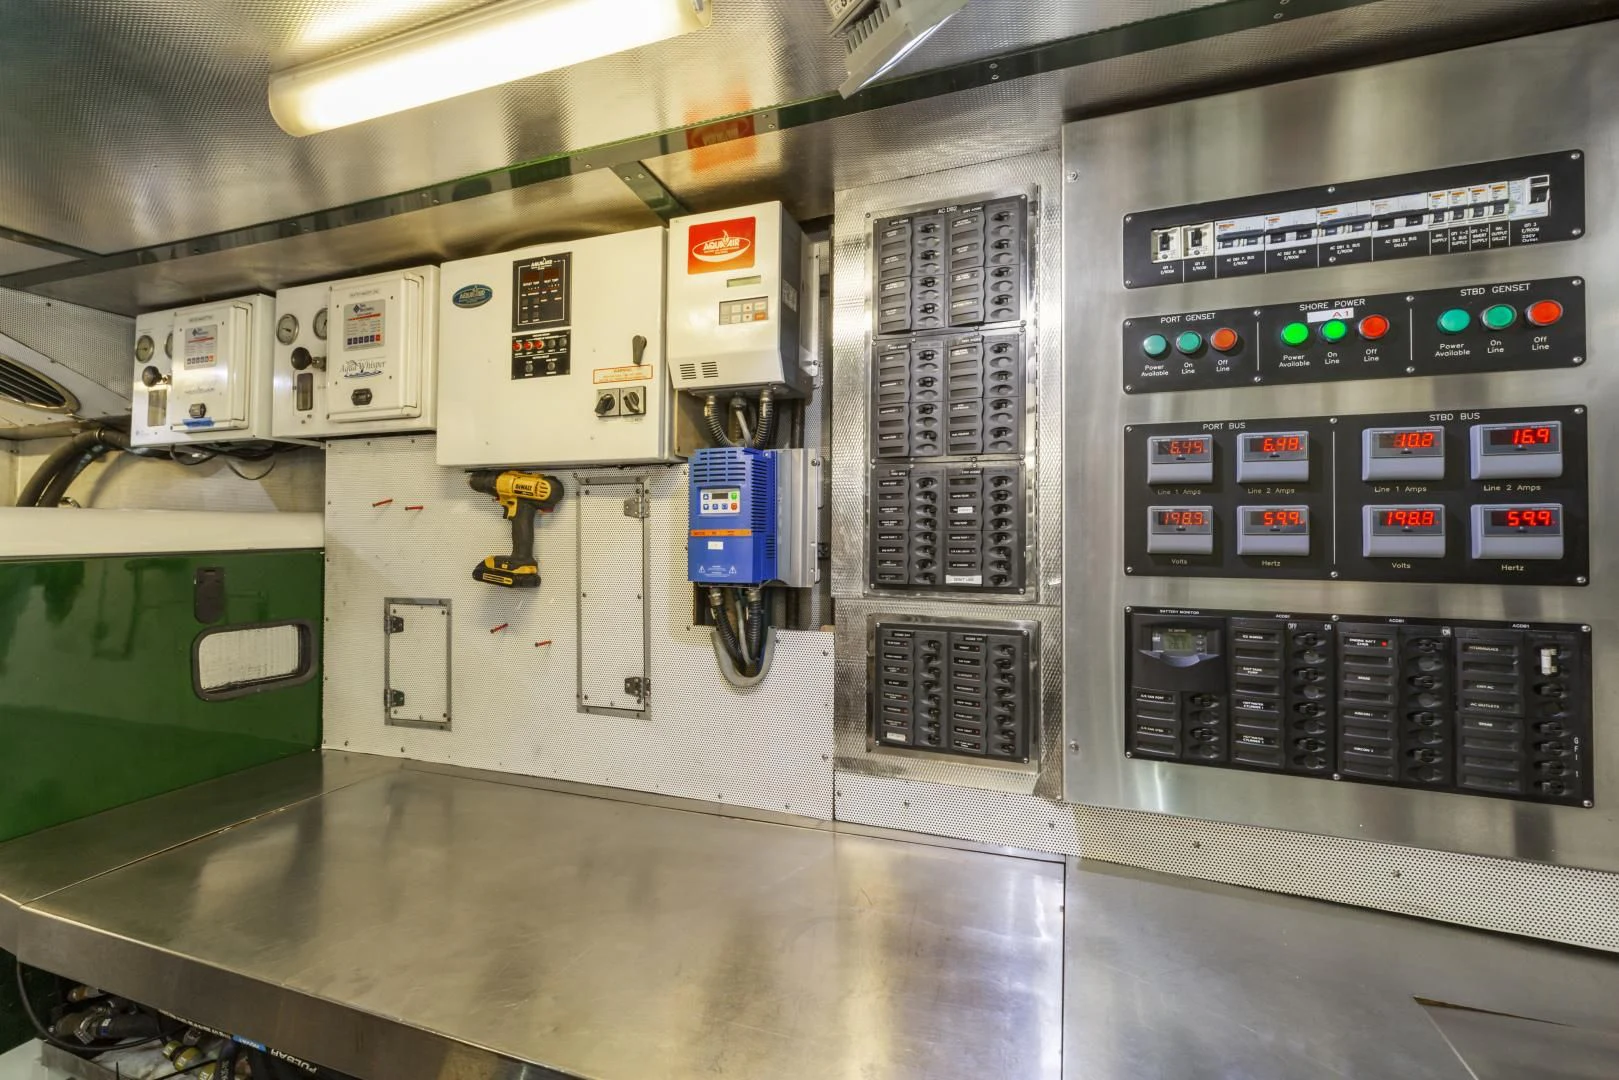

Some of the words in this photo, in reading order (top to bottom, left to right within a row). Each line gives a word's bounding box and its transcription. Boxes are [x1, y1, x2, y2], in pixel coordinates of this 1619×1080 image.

[702, 239, 726, 250] AQUA
[726, 238, 740, 248] AIR
[1460, 287, 1486, 298] STBD
[1492, 282, 1531, 294] GENSET
[1299, 302, 1329, 312] SHORE
[1334, 298, 1366, 308] POWER
[1160, 315, 1181, 324] PORT
[1185, 312, 1216, 322] GENSET
[1434, 349, 1471, 358] Available
[1278, 360, 1311, 368] Available
[1429, 413, 1454, 422] STBD
[1460, 412, 1481, 421] BUS
[1512, 428, 1550, 446] 16.9
[1263, 436, 1299, 452] 6.48
[1404, 486, 1427, 494] Amps
[1516, 484, 1542, 493] Amps
[1264, 512, 1299, 526] 59.9
[1386, 510, 1434, 527] 198.8
[1507, 510, 1552, 527] 59.9
[1501, 564, 1525, 572] Hertz
